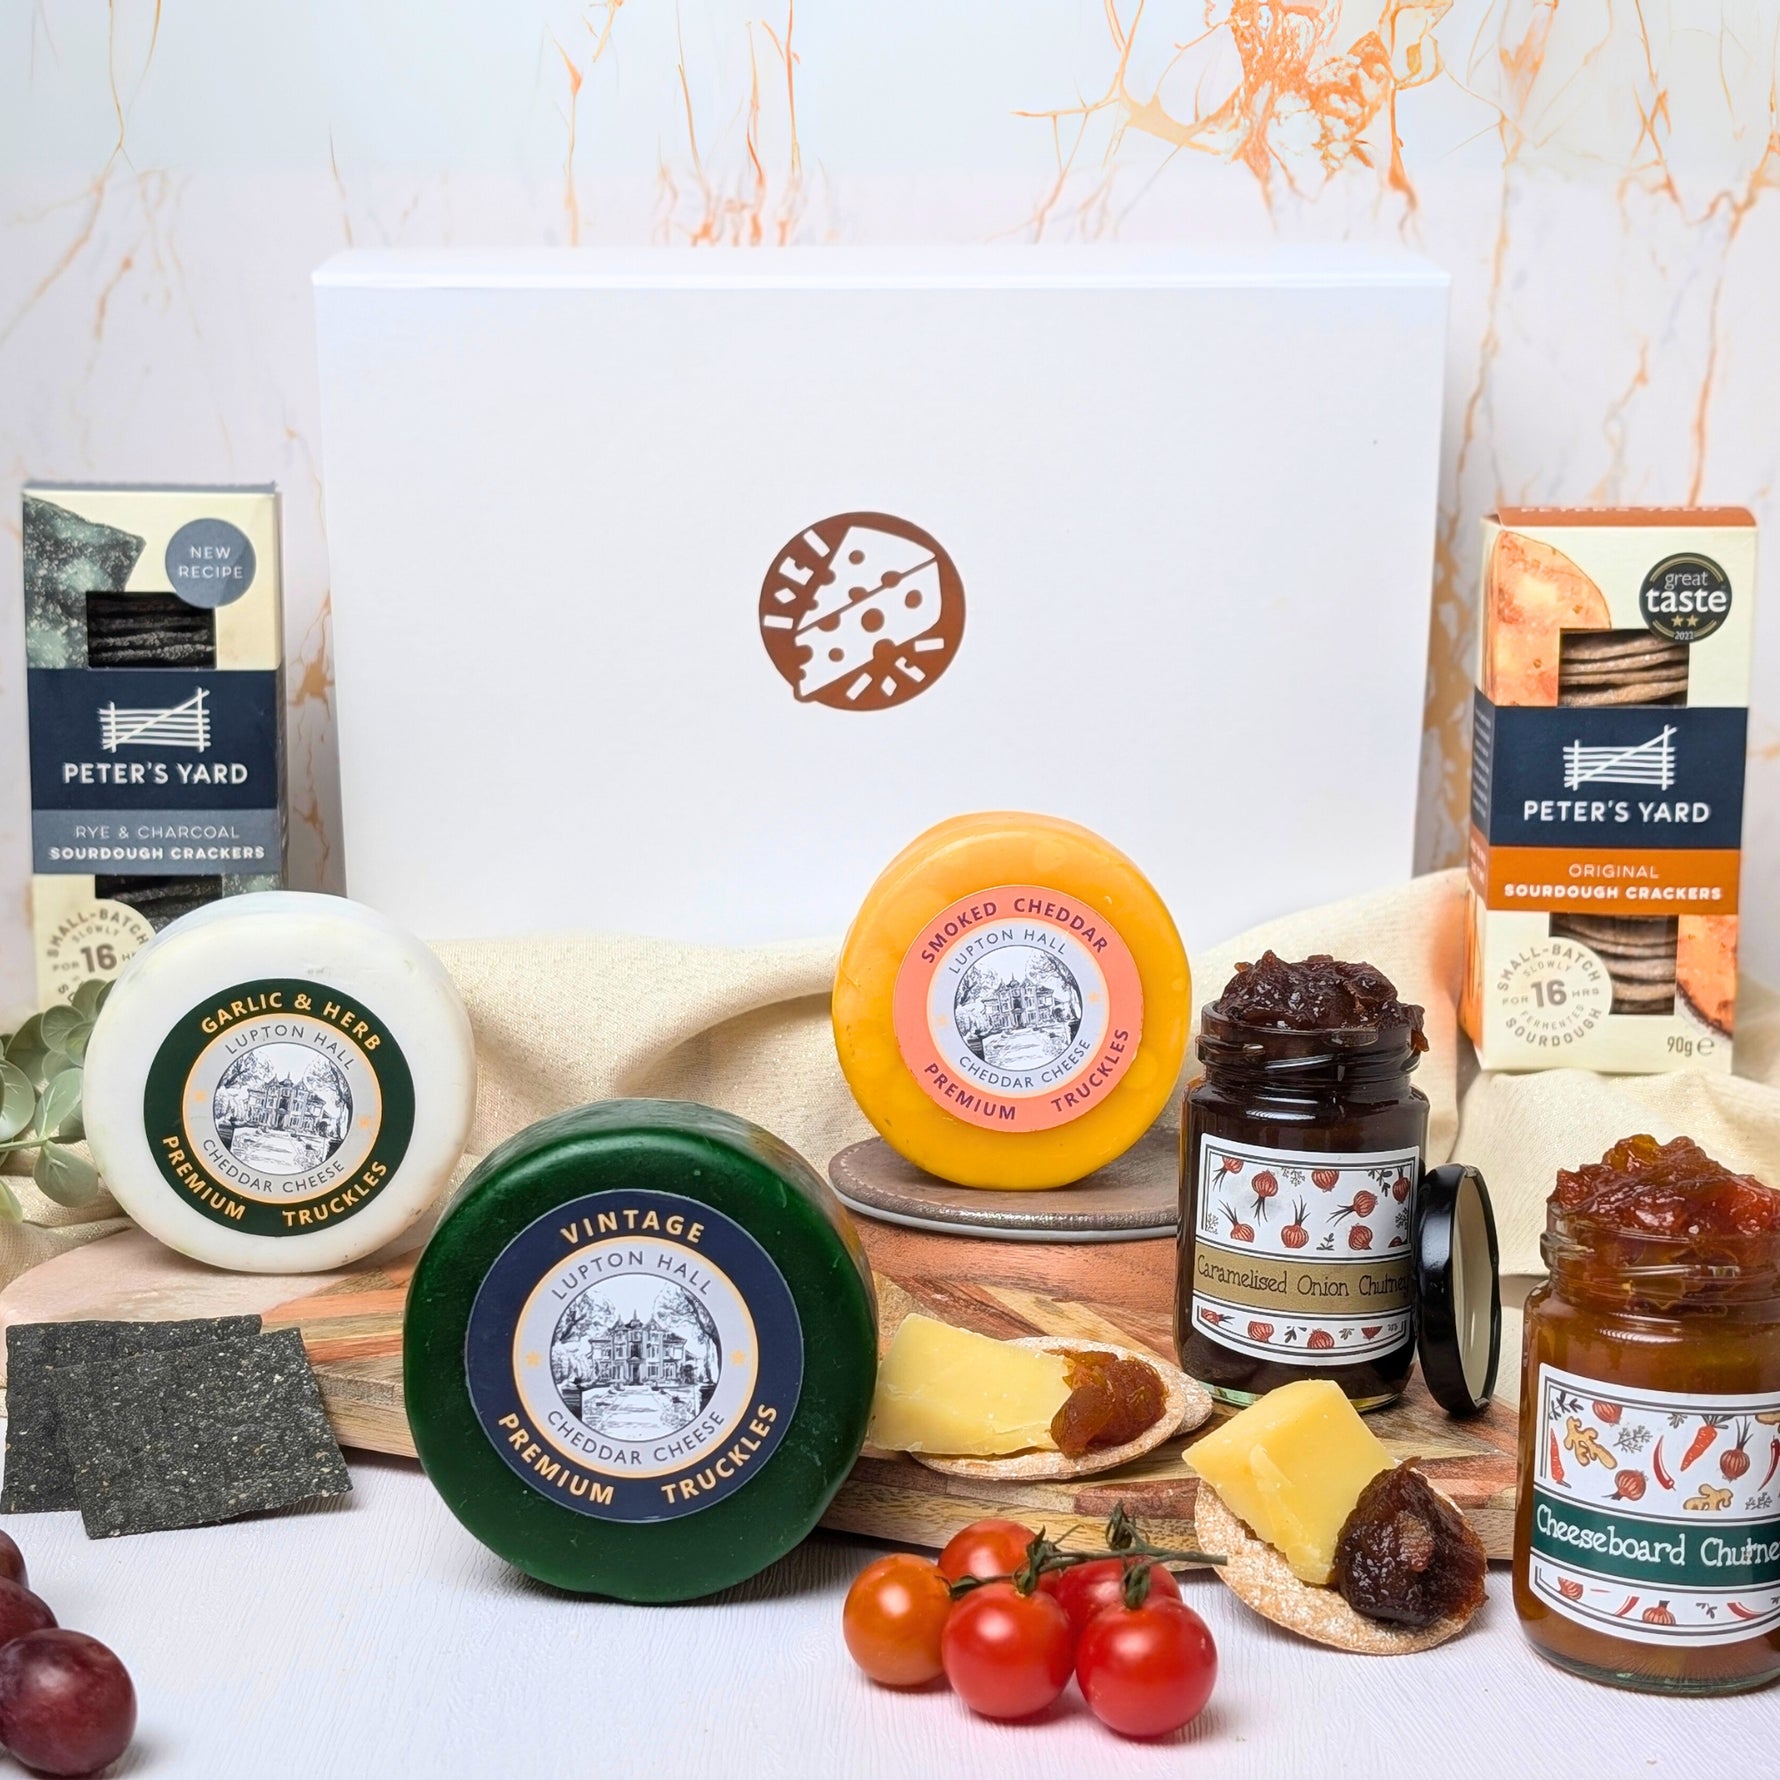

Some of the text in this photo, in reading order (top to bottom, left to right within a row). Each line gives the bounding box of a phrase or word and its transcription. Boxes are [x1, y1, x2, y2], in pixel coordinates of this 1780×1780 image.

[191, 546, 231, 558] NEW
[179, 565, 244, 579] RECIPE
[1664, 571, 1708, 590] great
[1646, 588, 1727, 613] taste
[64, 763, 249, 784] PETER'S YARD
[1524, 800, 1711, 823] PETER'S YARD
[75, 825, 240, 839] RYE & CHARCOAL
[50, 846, 265, 860] SOURDOUGH CRACKERS
[1568, 863, 1659, 879] ORIGINAL
[1504, 884, 1722, 900] SOURDOUGH CRACKERS
[47, 908, 149, 957] SMALL-BATCH
[921, 898, 1108, 963] SMOKED CHEDDAR
[52, 961, 79, 972] FOR
[80, 943, 117, 973] 16
[949, 928, 1067, 974] LUPTON HALL
[1497, 943, 1601, 991] SMALL-BATCH
[1522, 960, 1572, 978] SLOWLY
[1502, 979, 1600, 1008] FOR 16 HRS
[201, 992, 381, 1050] GARLIC & HERB
[1505, 1008, 1602, 1047] SOURDOUGH
[225, 1025, 355, 1070] LUPTON HALL
[959, 1039, 1091, 1088] CHEDDAR CHEESE
[1667, 1035, 1693, 1058] 90g
[924, 1029, 1129, 1120] PREMIUM TRUCKLES
[163, 1135, 388, 1227] PREMIUM TRUCKLES
[203, 1139, 345, 1193] CHEDDAR CHEESE
[560, 1209, 705, 1244] VINTAGE
[552, 1251, 714, 1300] LUPTON HALL
[1198, 1254, 1409, 1298] Caramelised Onion Chutney
[498, 1403, 778, 1505] PREMIUM TRUCKLES
[548, 1410, 725, 1465] CHEDDAR CHEESE
[1536, 1504, 1780, 1567] Cheeseboard Chutne
